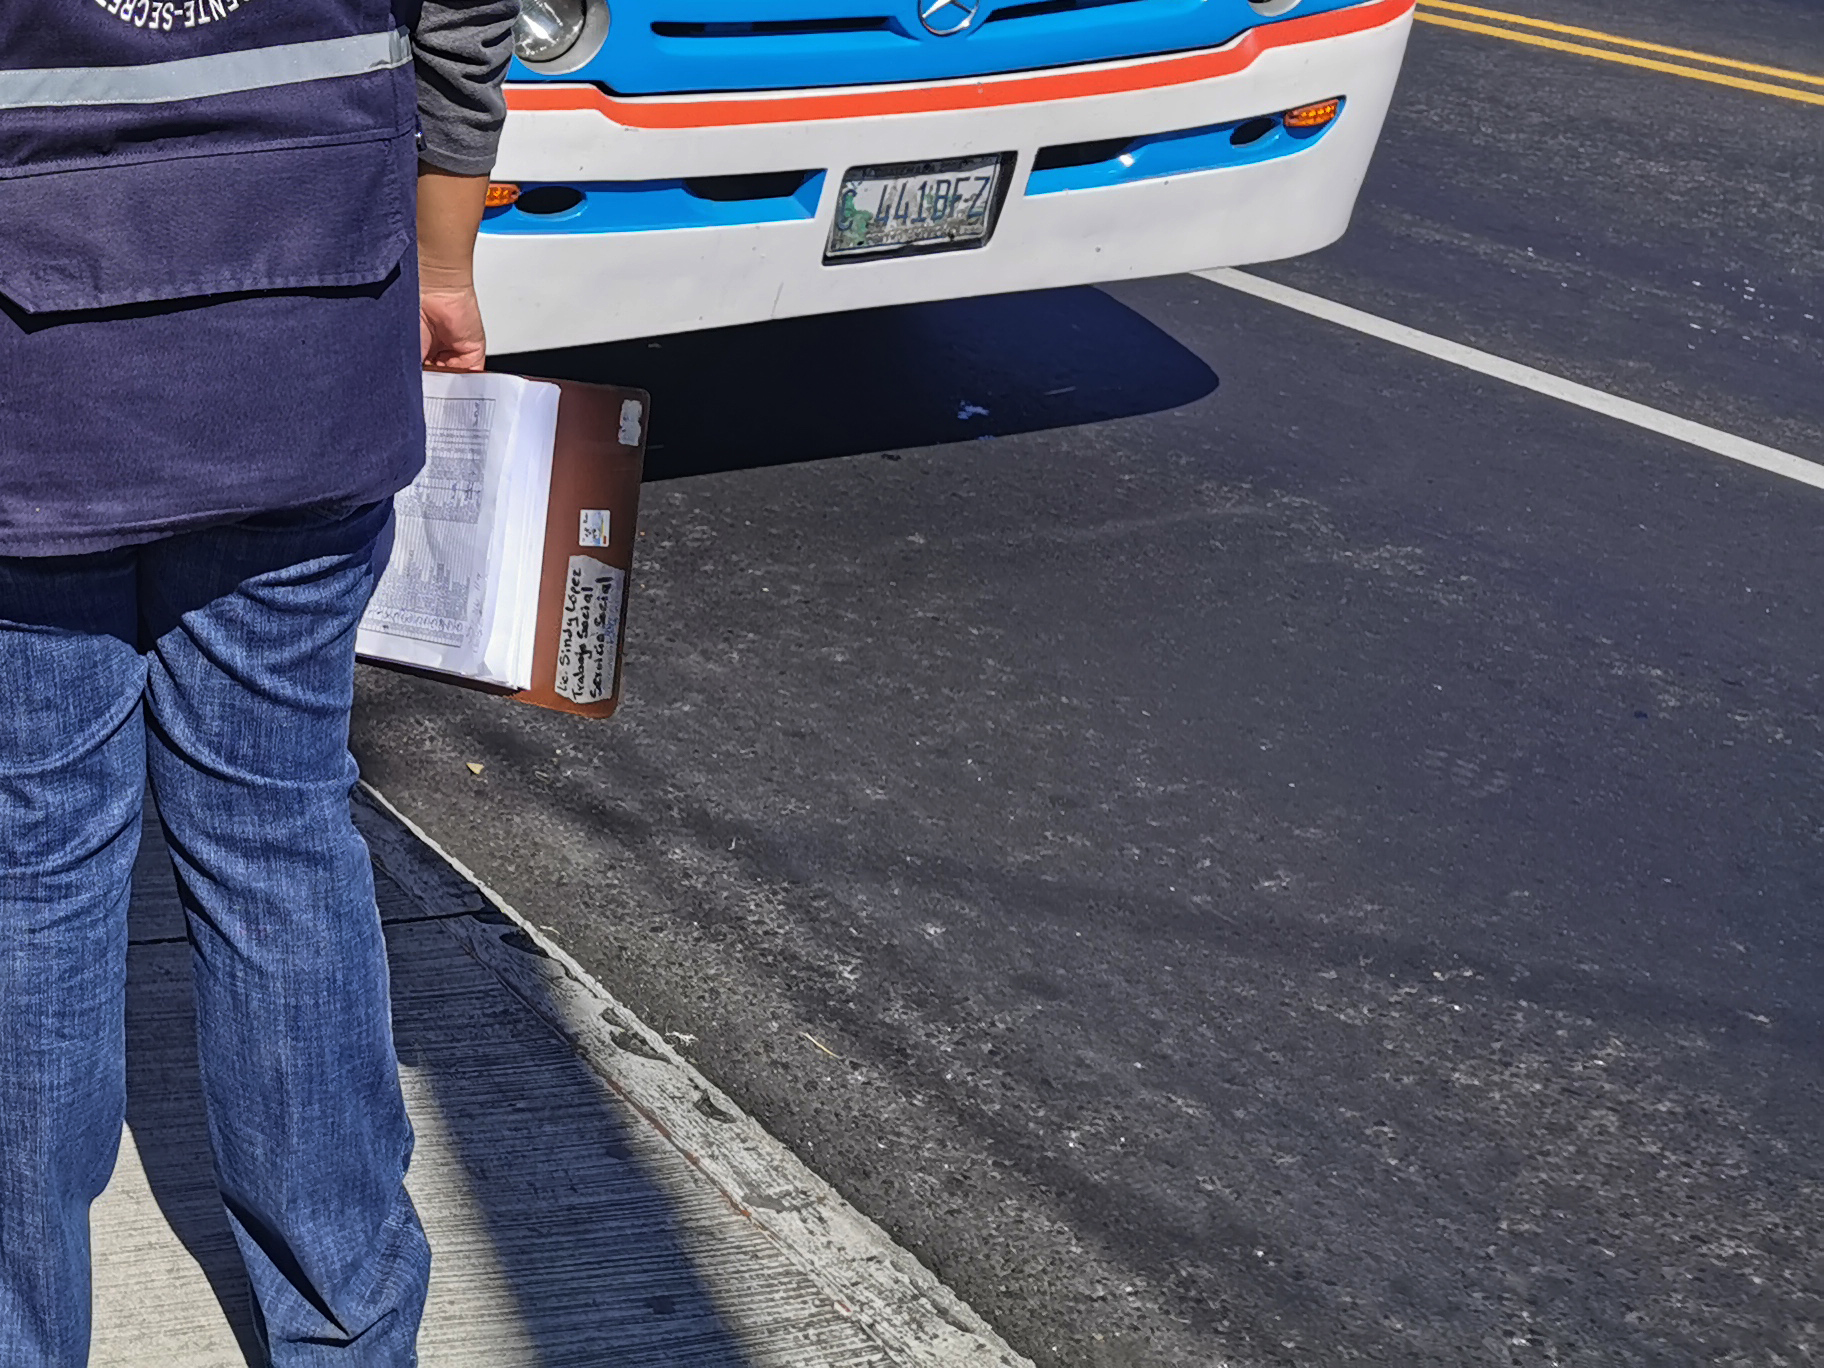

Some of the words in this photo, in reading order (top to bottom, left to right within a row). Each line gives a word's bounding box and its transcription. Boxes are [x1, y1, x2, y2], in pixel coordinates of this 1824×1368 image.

[577, 586, 594, 639] Social
[593, 576, 614, 627] Social
[559, 617, 579, 667] Sindy
